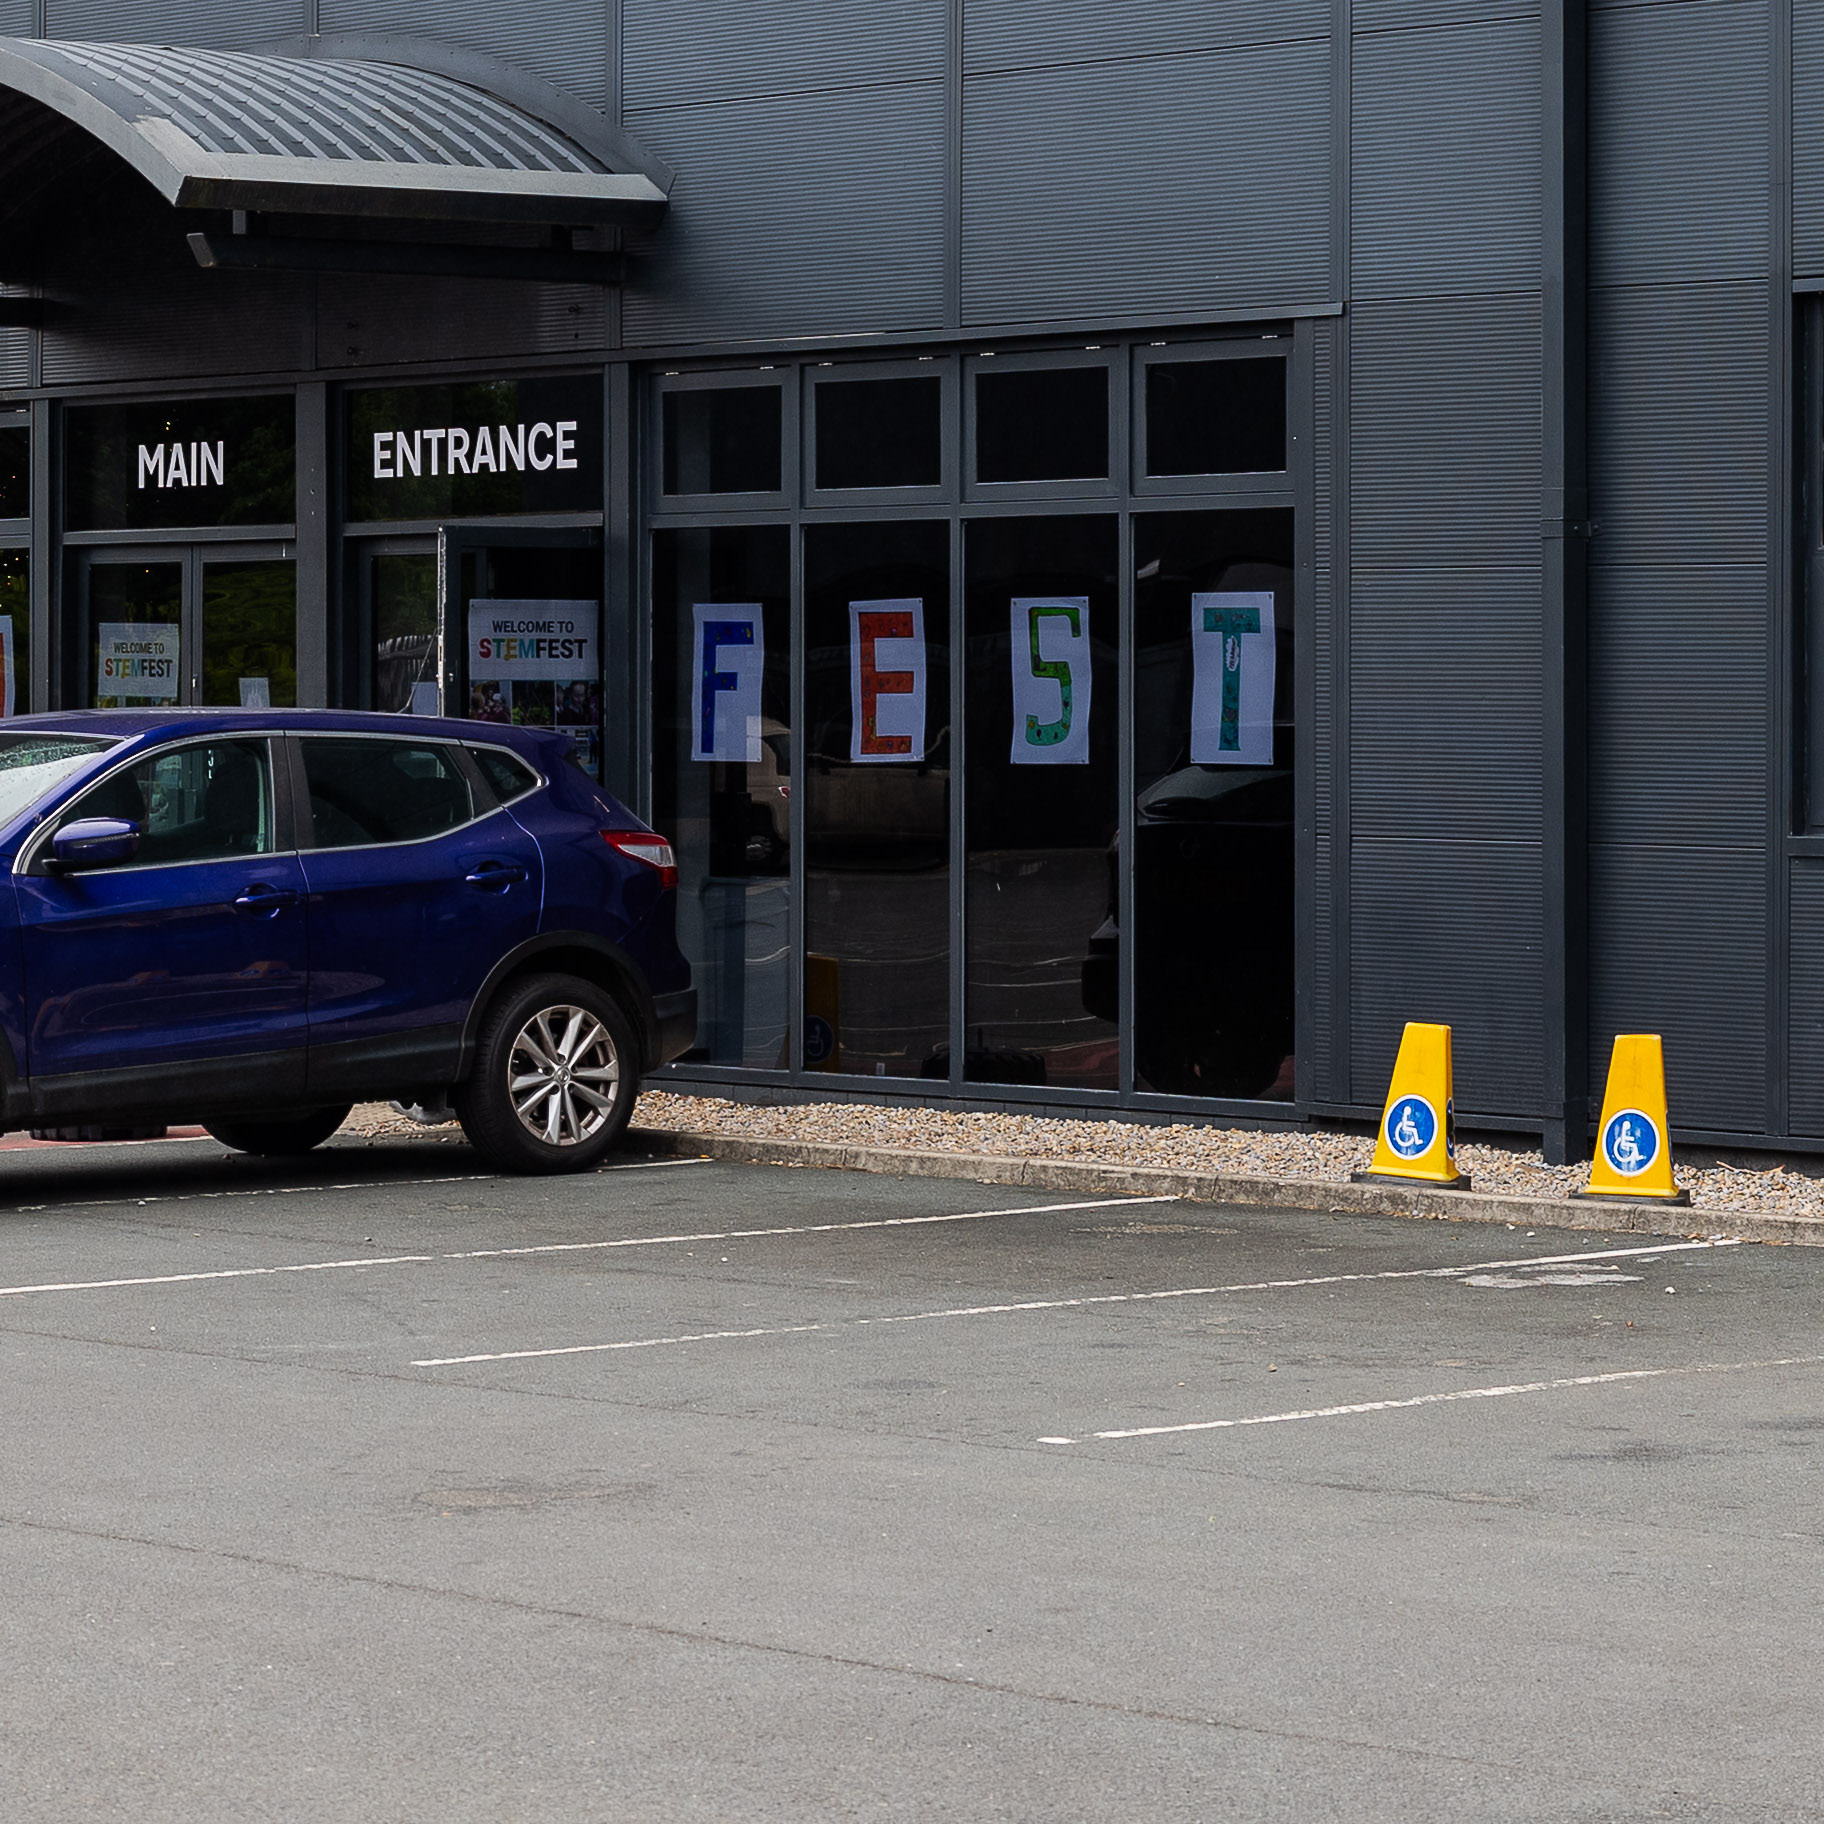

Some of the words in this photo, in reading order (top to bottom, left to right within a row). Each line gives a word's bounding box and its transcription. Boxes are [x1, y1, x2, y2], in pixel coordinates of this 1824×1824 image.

[138, 440, 225, 489] MAIN
[372, 420, 579, 479] ENTRANCE
[492, 620, 555, 634] WELCOME
[557, 621, 575, 634] TO
[113, 642, 153, 654] WELCOME
[154, 642, 165, 654] TO
[478, 637, 588, 661] STEMFEST
[104, 658, 173, 678] STEMFEST
